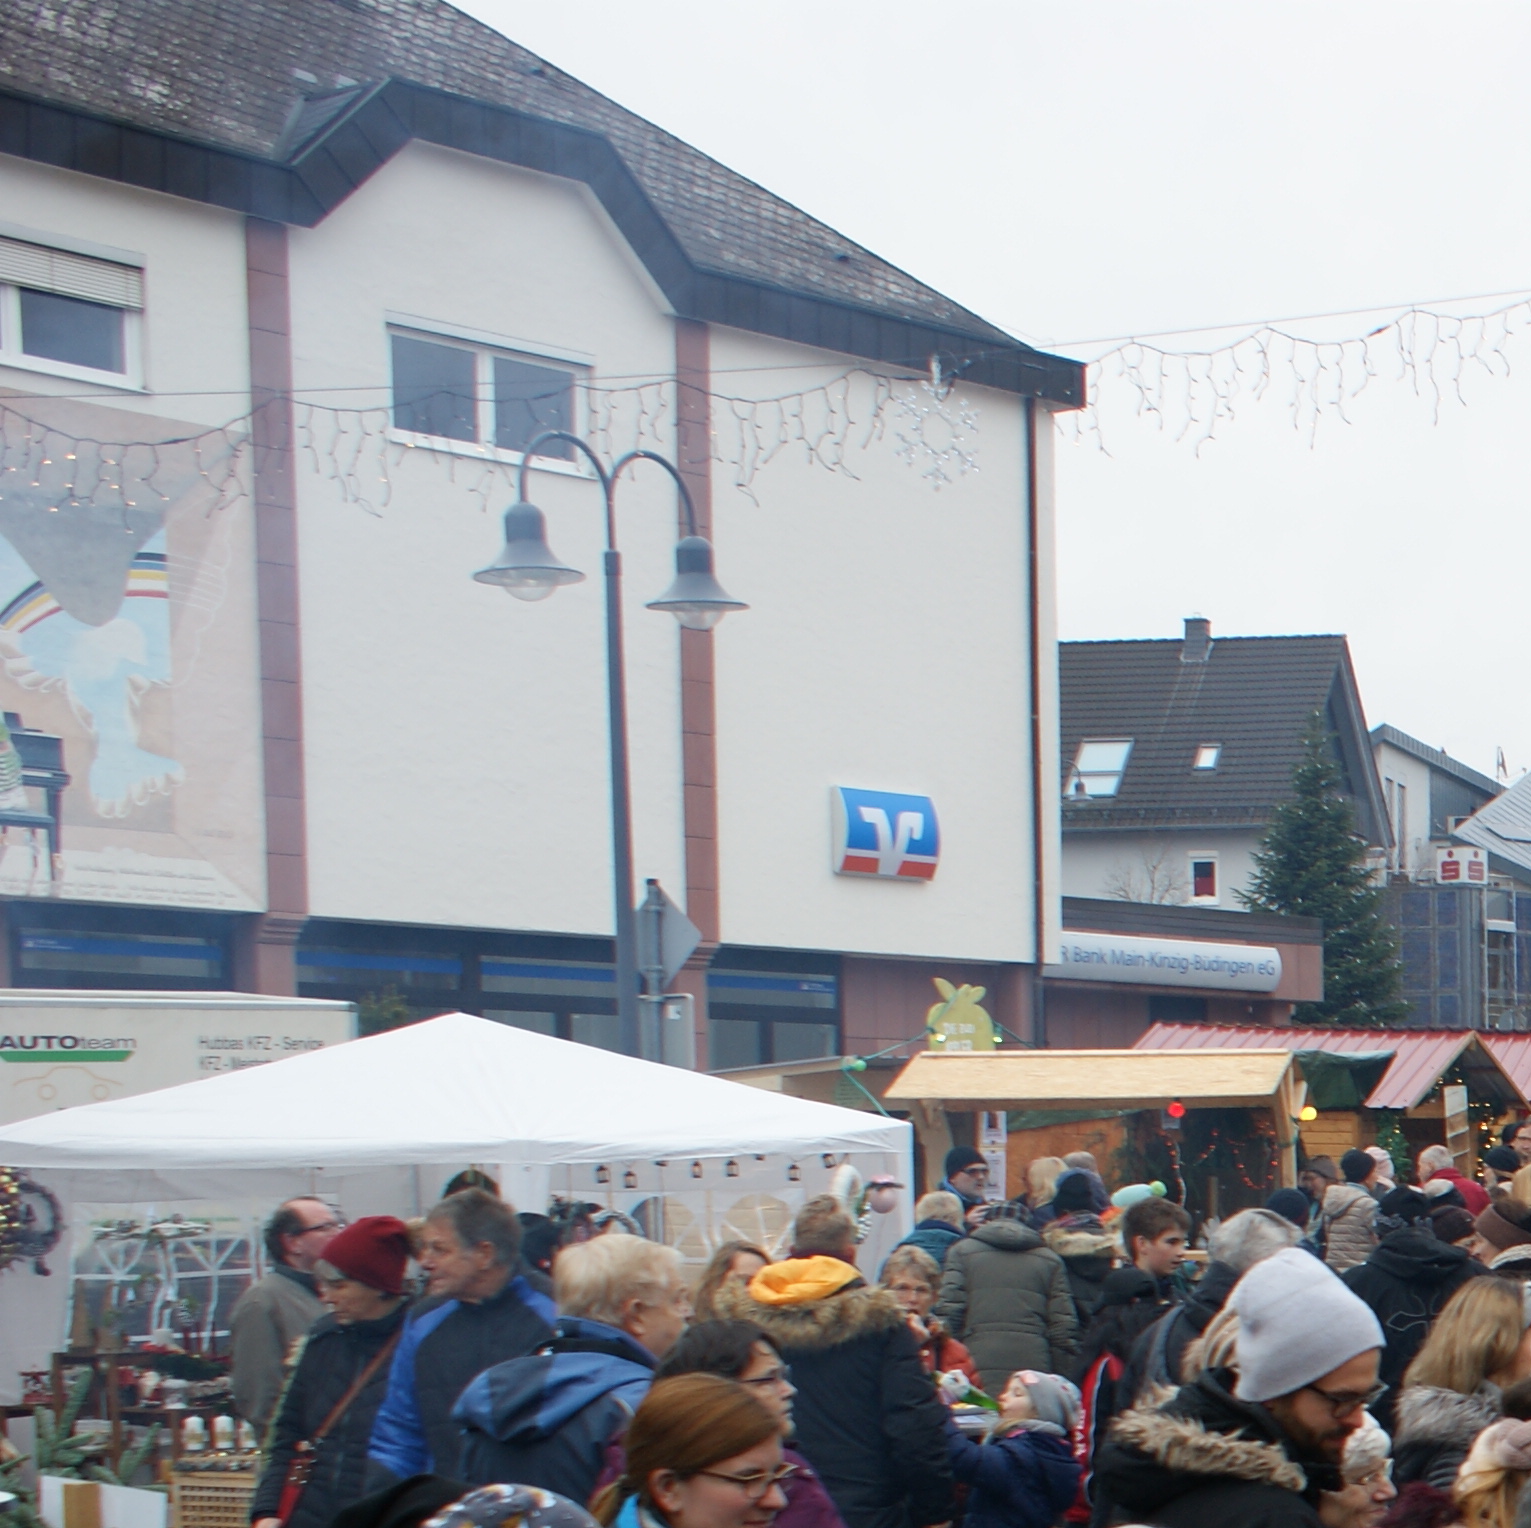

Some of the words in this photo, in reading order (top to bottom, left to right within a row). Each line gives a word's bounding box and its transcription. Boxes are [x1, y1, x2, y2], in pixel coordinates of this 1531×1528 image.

[1073, 946, 1107, 964] Bank
[1111, 949, 1254, 977] Main-Kinzig-Büdingen
[1258, 960, 1275, 976] eG
[0, 1035, 137, 1050] AUTOteam
[247, 1035, 271, 1050] KFZ
[283, 1035, 325, 1050] Service
[199, 1055, 221, 1071] KFZ
